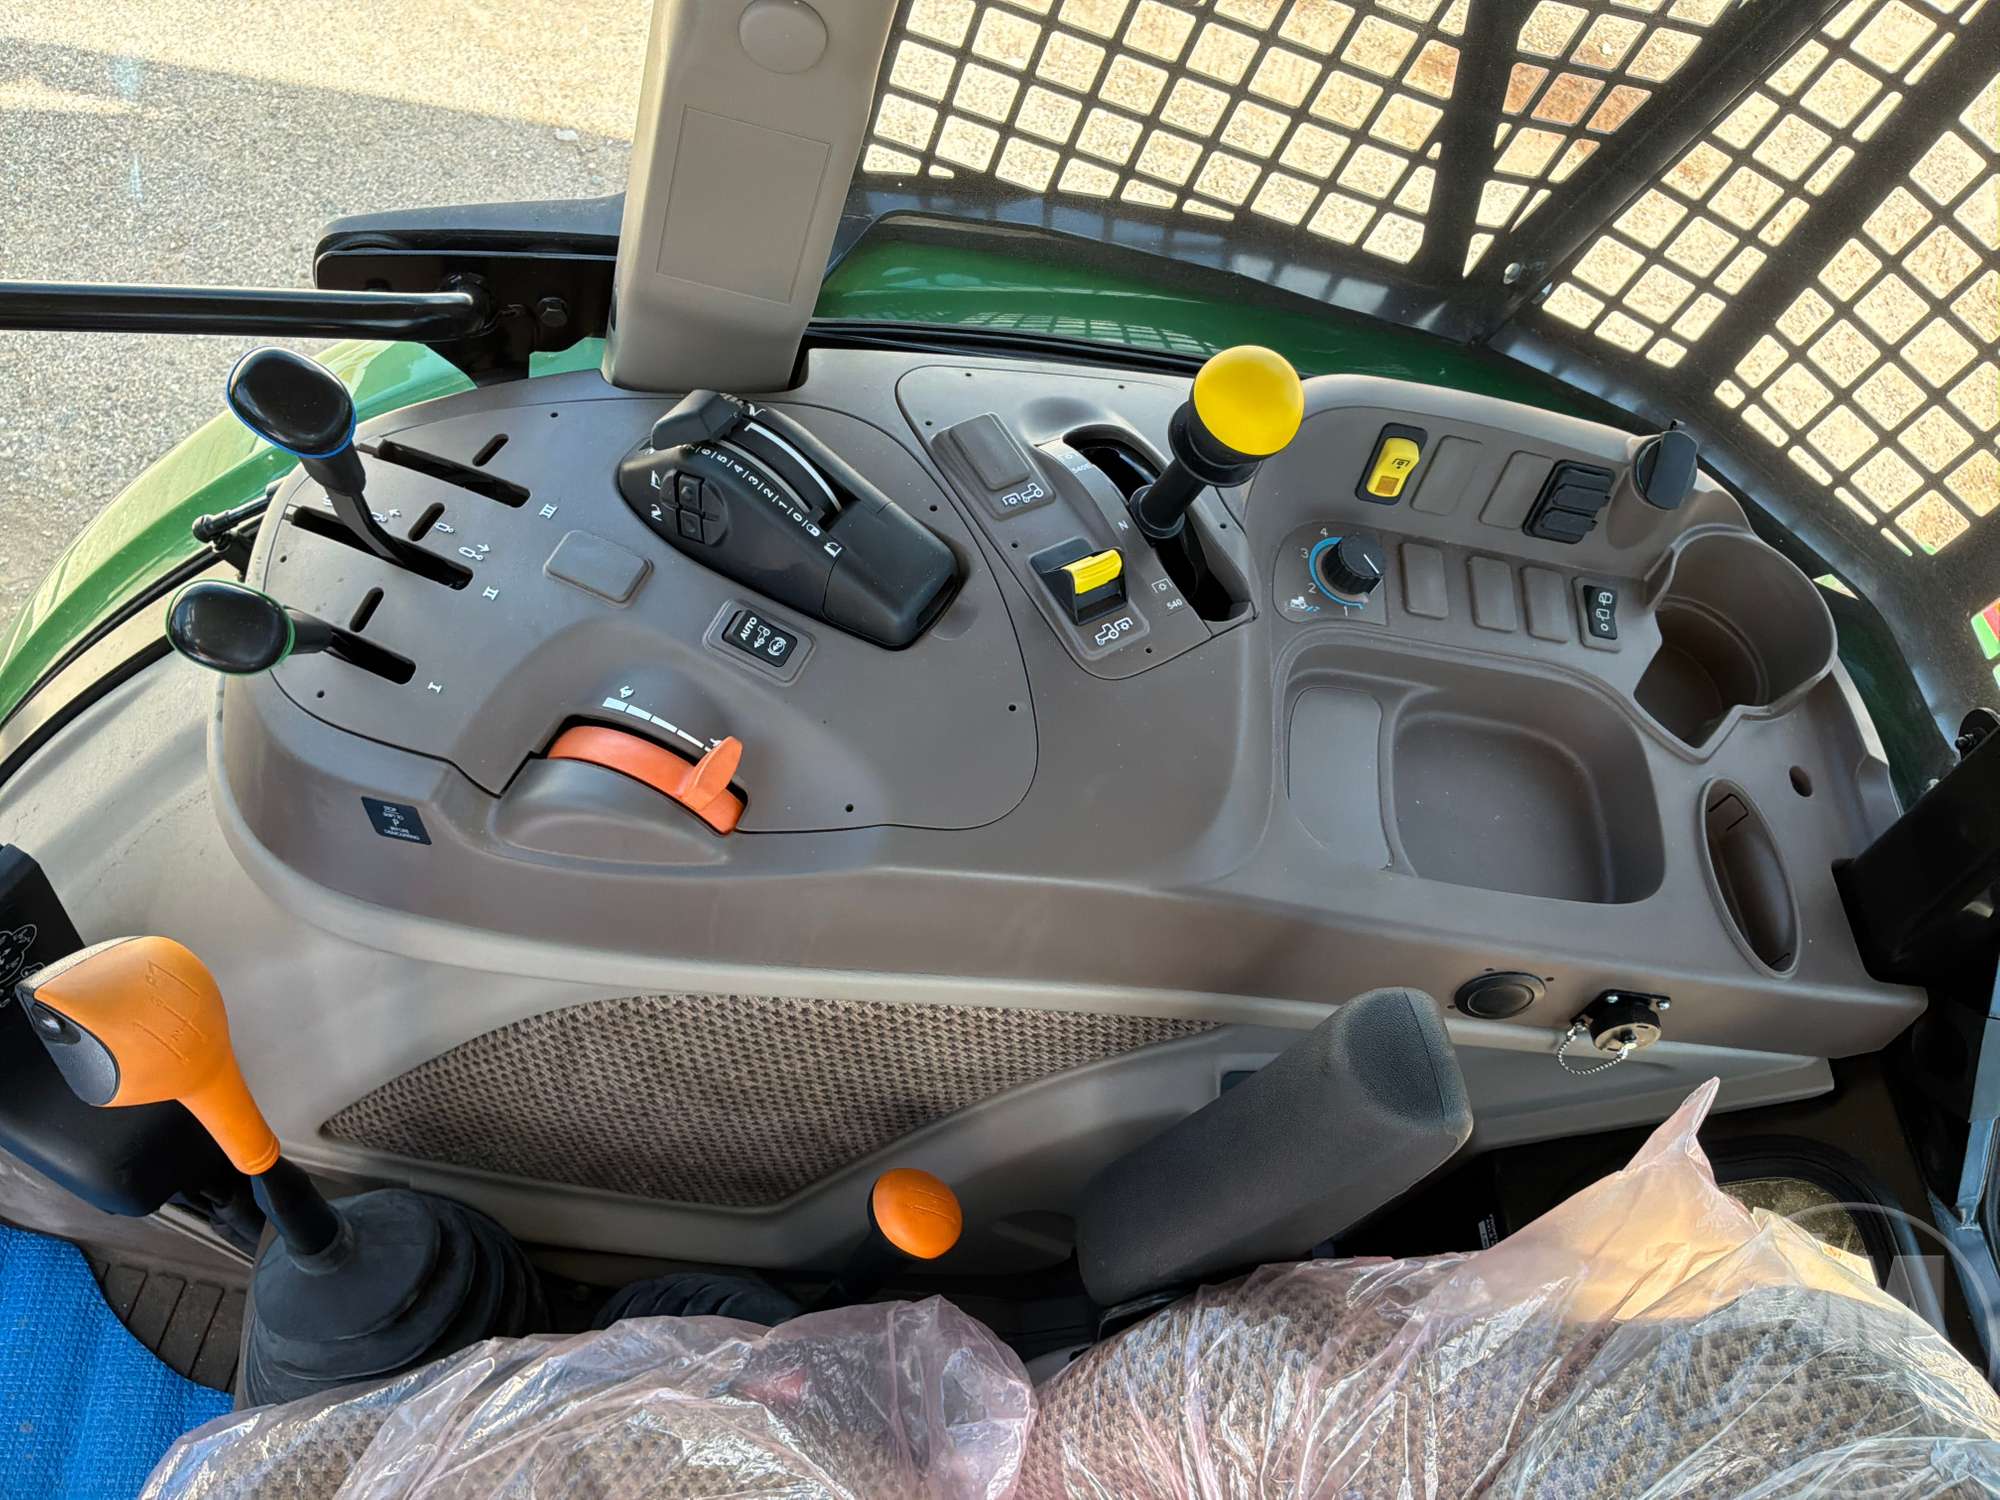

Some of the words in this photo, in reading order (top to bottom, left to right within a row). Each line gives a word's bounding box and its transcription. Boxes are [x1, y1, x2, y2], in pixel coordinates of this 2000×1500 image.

[701, 448, 711, 456] 6
[716, 455, 728, 463] 5
[734, 464, 744, 473] 4
[748, 475, 759, 485] 3
[763, 488, 774, 498] 2
[1166, 598, 1183, 610] 540
[740, 616, 758, 641] AUTO
